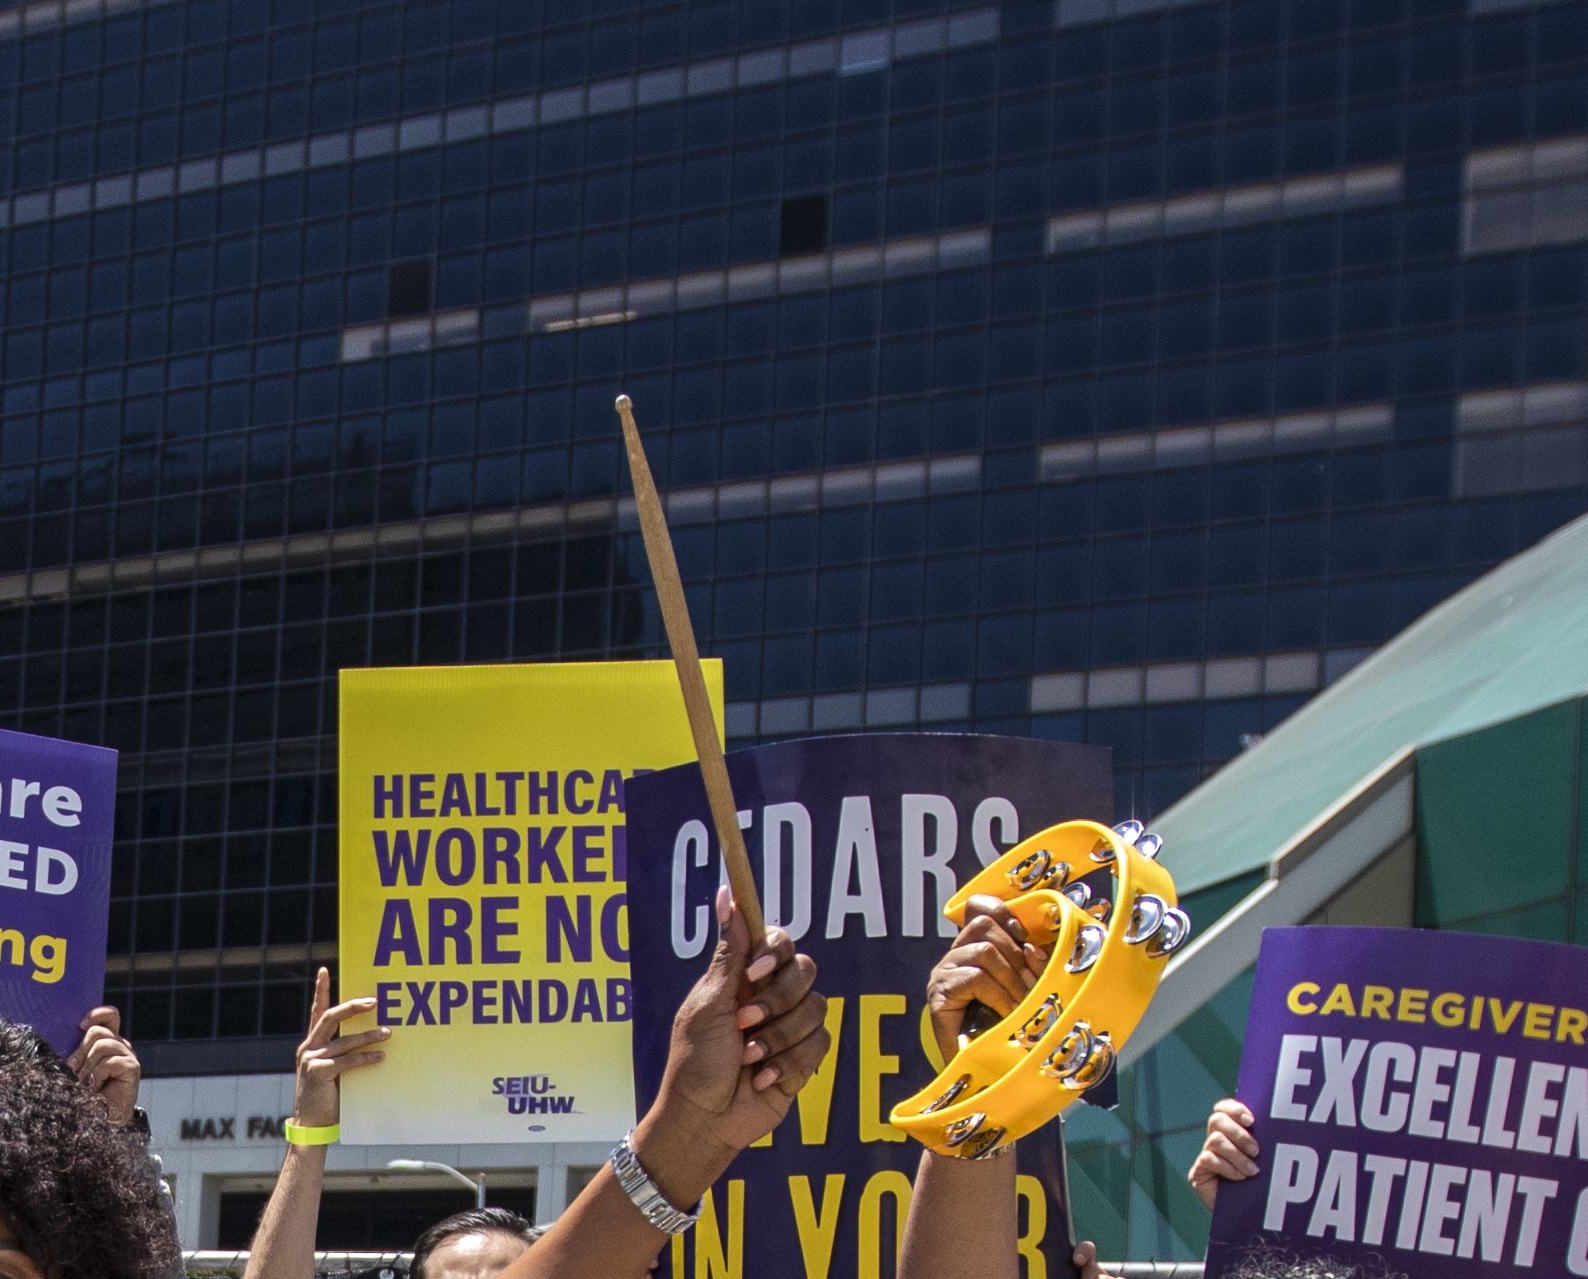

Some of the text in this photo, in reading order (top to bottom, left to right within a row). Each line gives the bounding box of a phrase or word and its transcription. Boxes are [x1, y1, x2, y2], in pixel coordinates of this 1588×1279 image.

[372, 769, 657, 819] HEALTHCA
[371, 824, 627, 887] WORKE
[372, 891, 631, 967] ARE NO
[374, 977, 634, 1027] EXPENDAB
[491, 1076, 557, 1095] SEIU-
[507, 1096, 575, 1115] UHW
[181, 1117, 235, 1140] MAX
[1263, 1142, 1559, 1268] PATIENT
